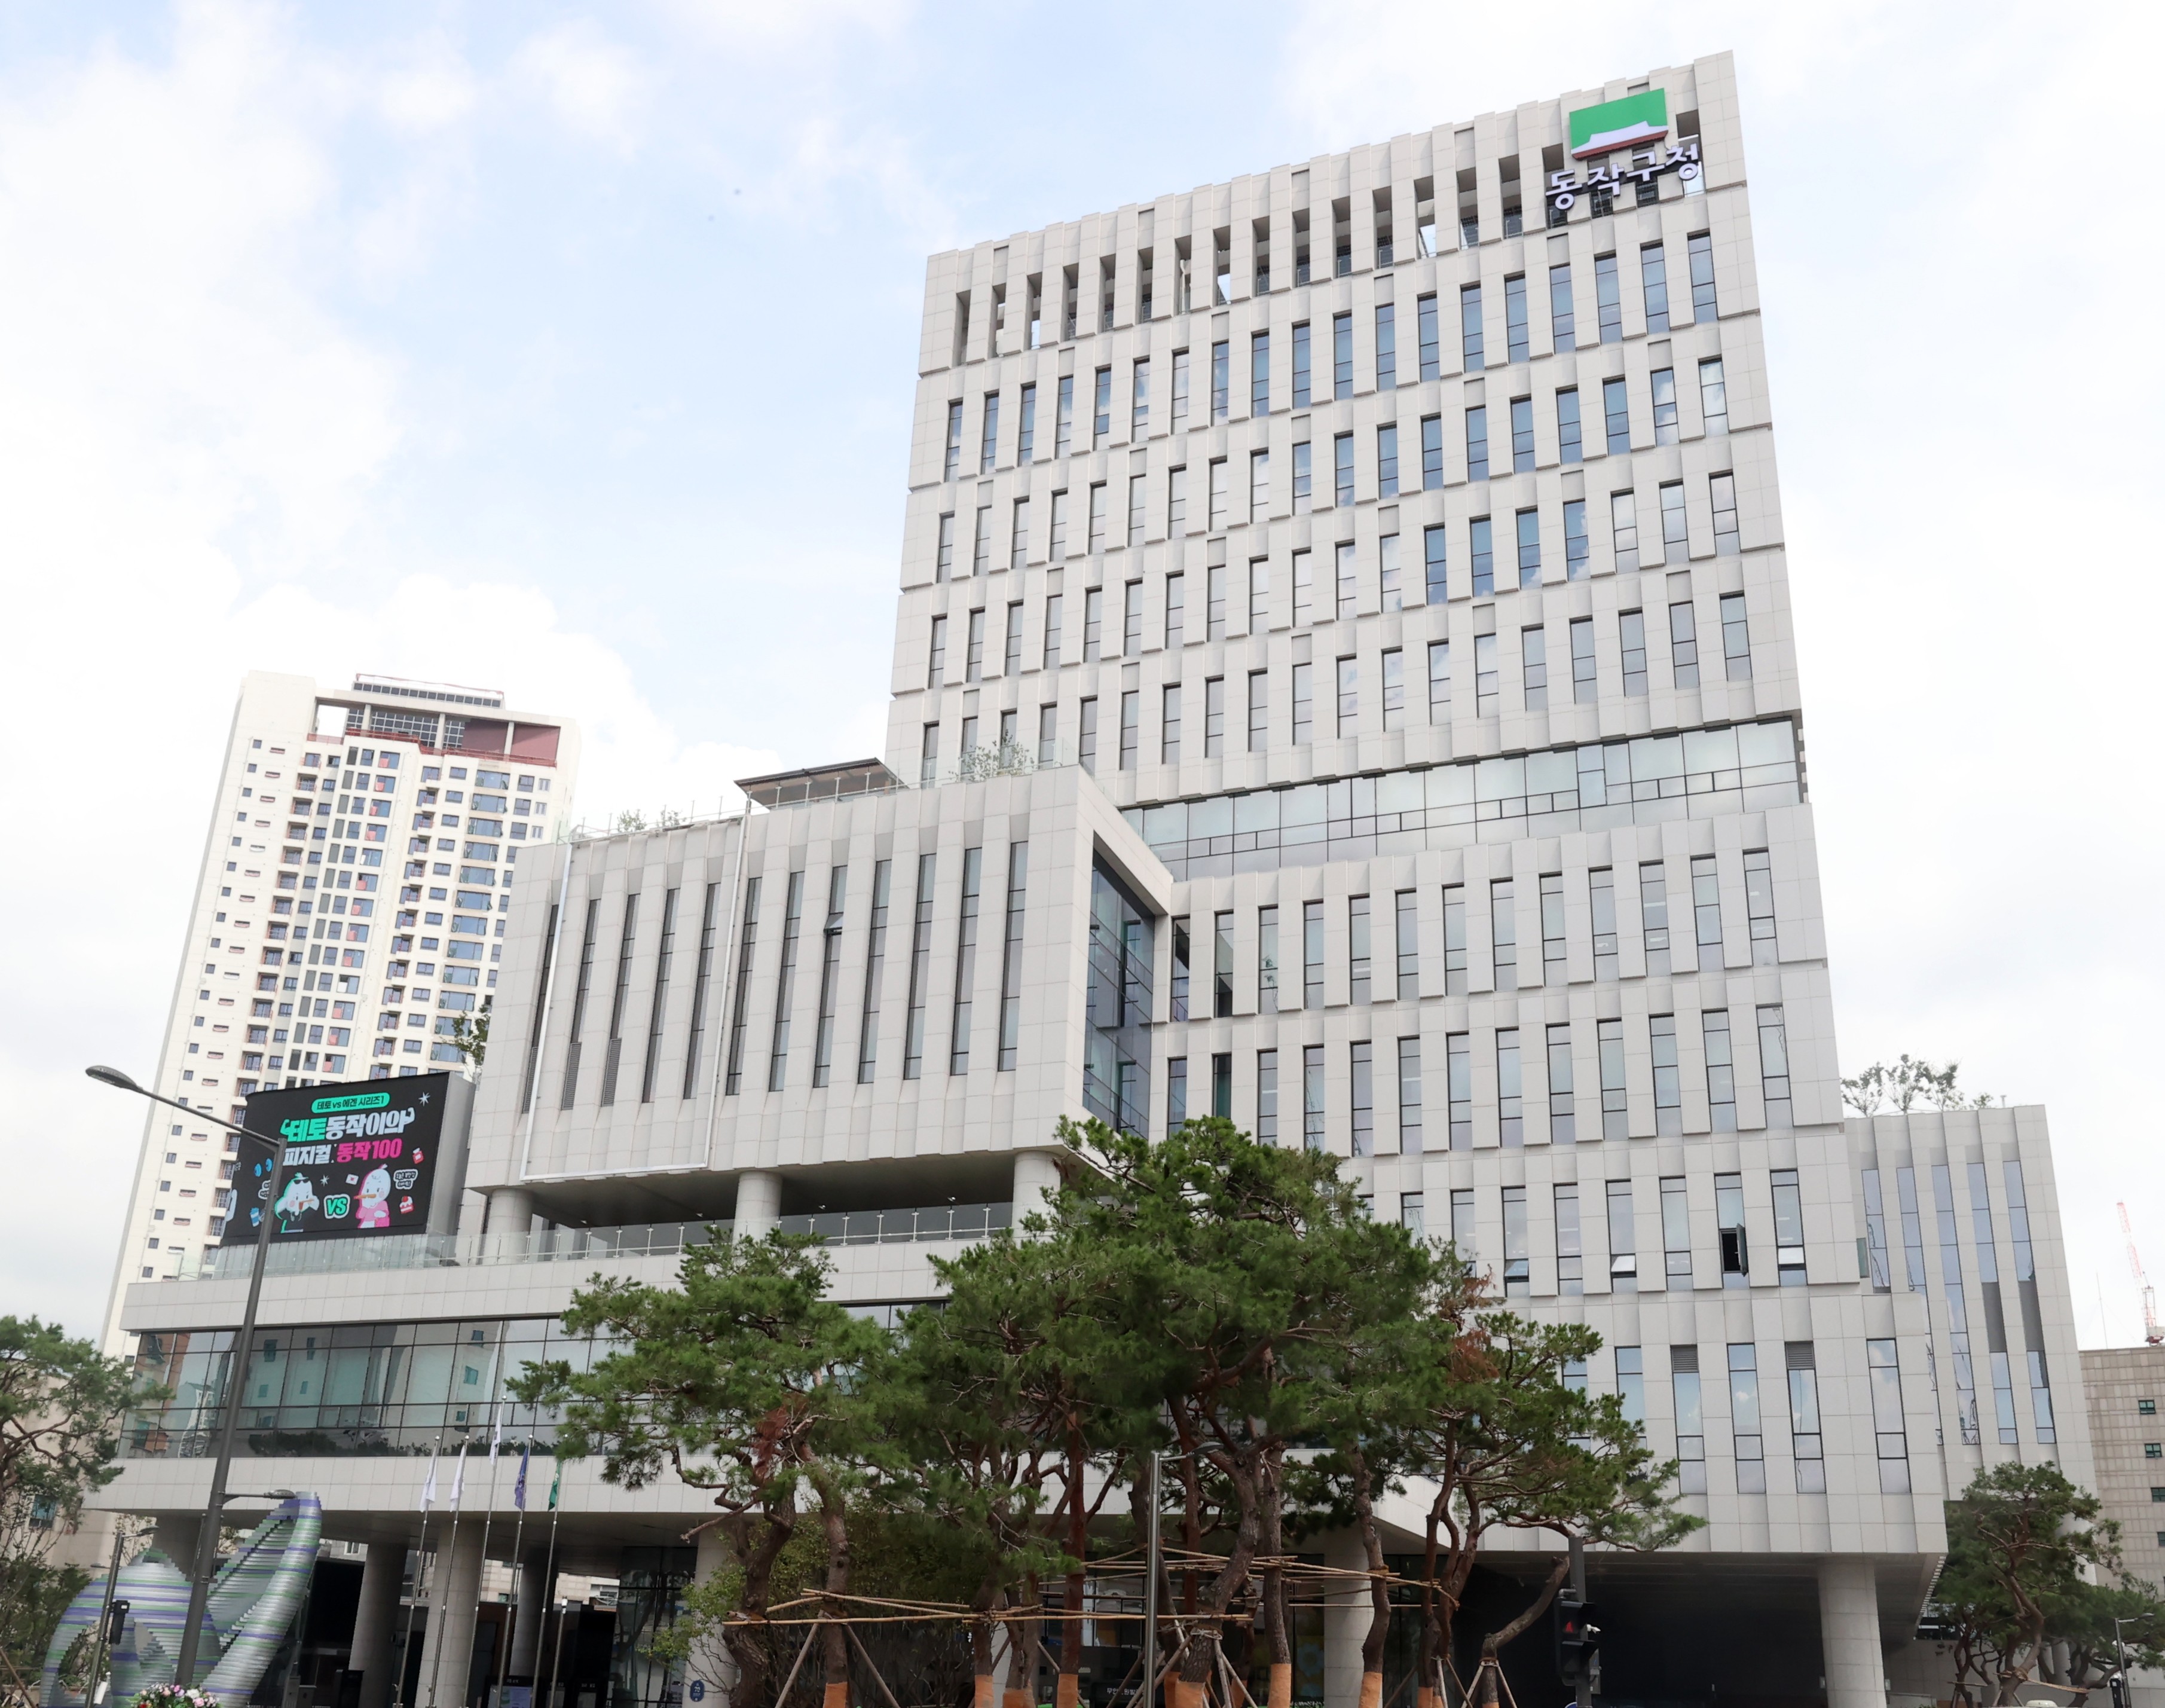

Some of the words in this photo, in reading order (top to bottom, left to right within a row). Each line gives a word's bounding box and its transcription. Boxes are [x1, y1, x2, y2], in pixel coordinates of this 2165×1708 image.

[1546, 143, 1699, 210] 동작구청
[317, 1101, 331, 1110] 테토
[343, 1098, 357, 1108] 에겐
[326, 1196, 348, 1217] VS
